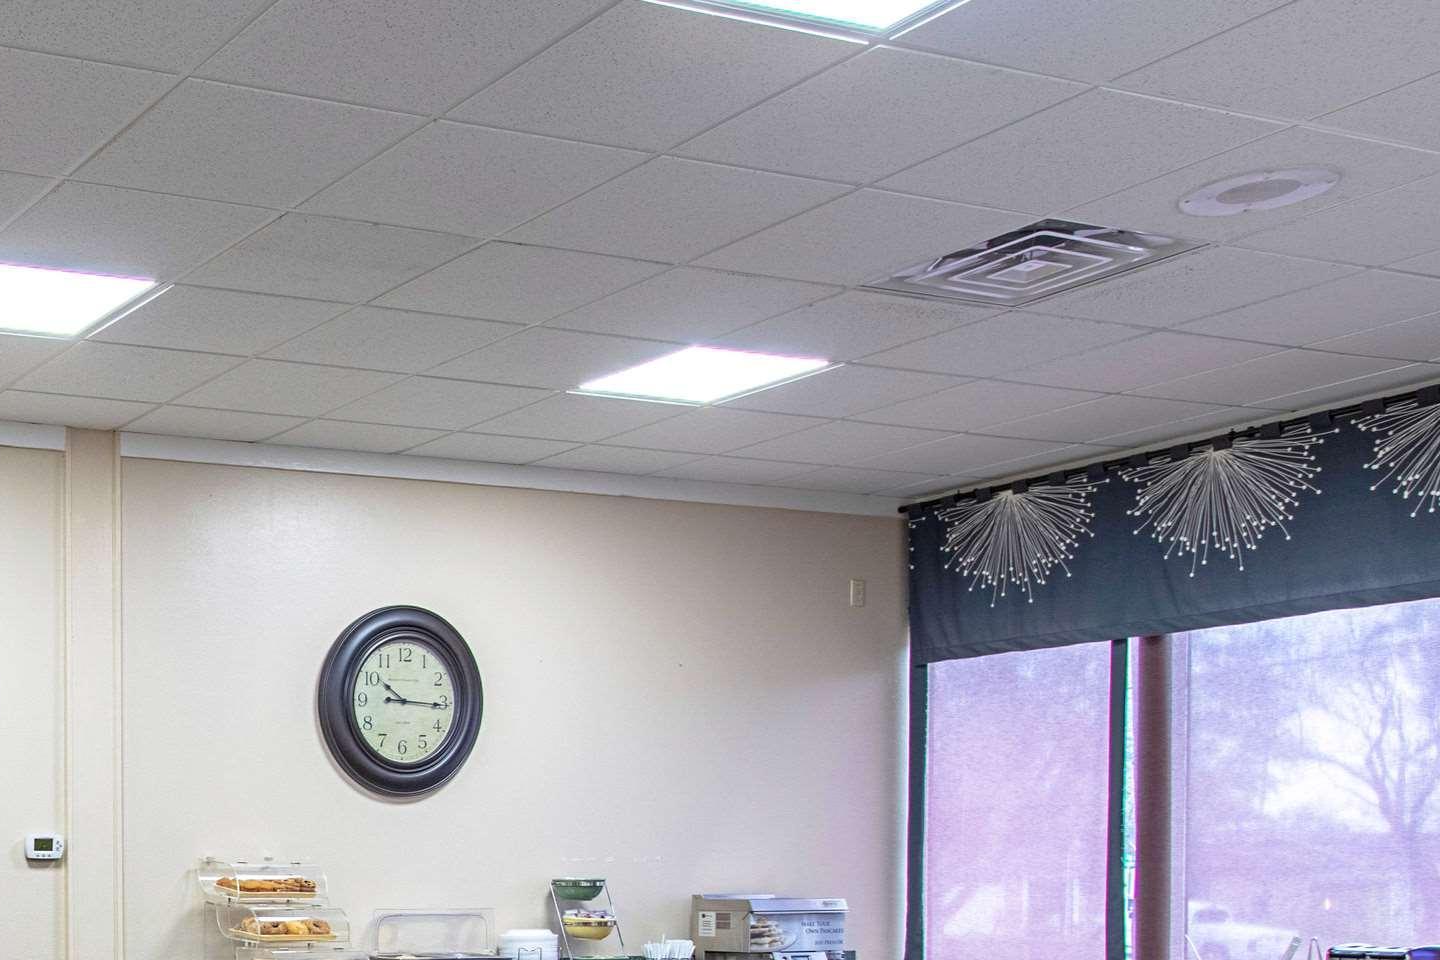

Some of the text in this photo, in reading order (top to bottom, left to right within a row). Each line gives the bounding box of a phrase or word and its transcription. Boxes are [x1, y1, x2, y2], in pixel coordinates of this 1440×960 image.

[379, 654, 390, 668] 11
[399, 648, 412, 662] 12
[422, 655, 426, 668] 1
[365, 671, 380, 686] 10
[434, 672, 443, 686] 2
[358, 692, 368, 707] 9
[439, 695, 448, 710] 3
[362, 715, 373, 730] 8
[433, 720, 442, 732] 4
[378, 734, 387, 747] 7
[397, 740, 407, 755] 6
[418, 735, 427, 749] 5
